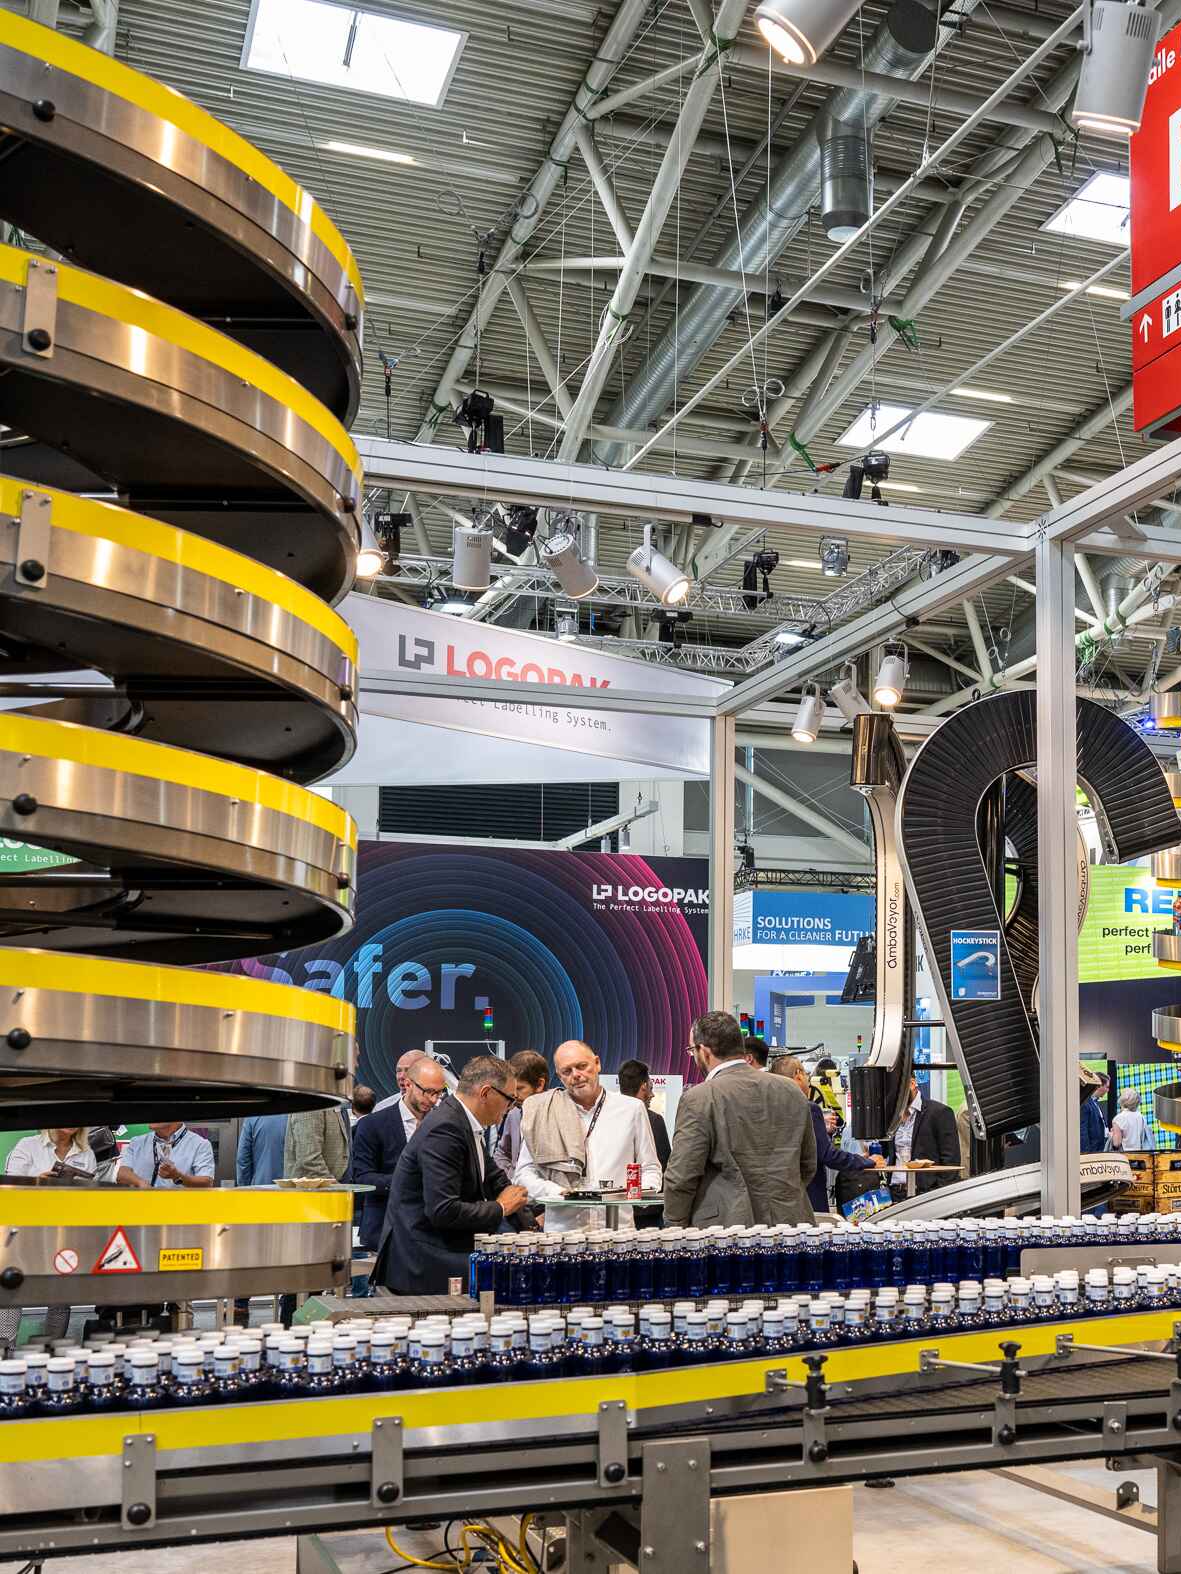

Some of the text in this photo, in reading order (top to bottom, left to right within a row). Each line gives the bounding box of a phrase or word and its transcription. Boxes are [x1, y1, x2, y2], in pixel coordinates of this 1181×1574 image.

[1148, 48, 1175, 85] alle
[566, 711, 612, 731] System.
[617, 886, 709, 904] LOGOPAK
[609, 903, 640, 912] Perfect
[643, 906, 681, 914] Labelling
[757, 916, 832, 930] SOLUTIONS
[757, 930, 874, 942] FOR A CLEANER FUT
[1102, 926, 1149, 938] perfect
[952, 937, 998, 945] HOCKEYSTICK
[1125, 942, 1152, 955] perf
[162, 1252, 200, 1262] PATENTED
